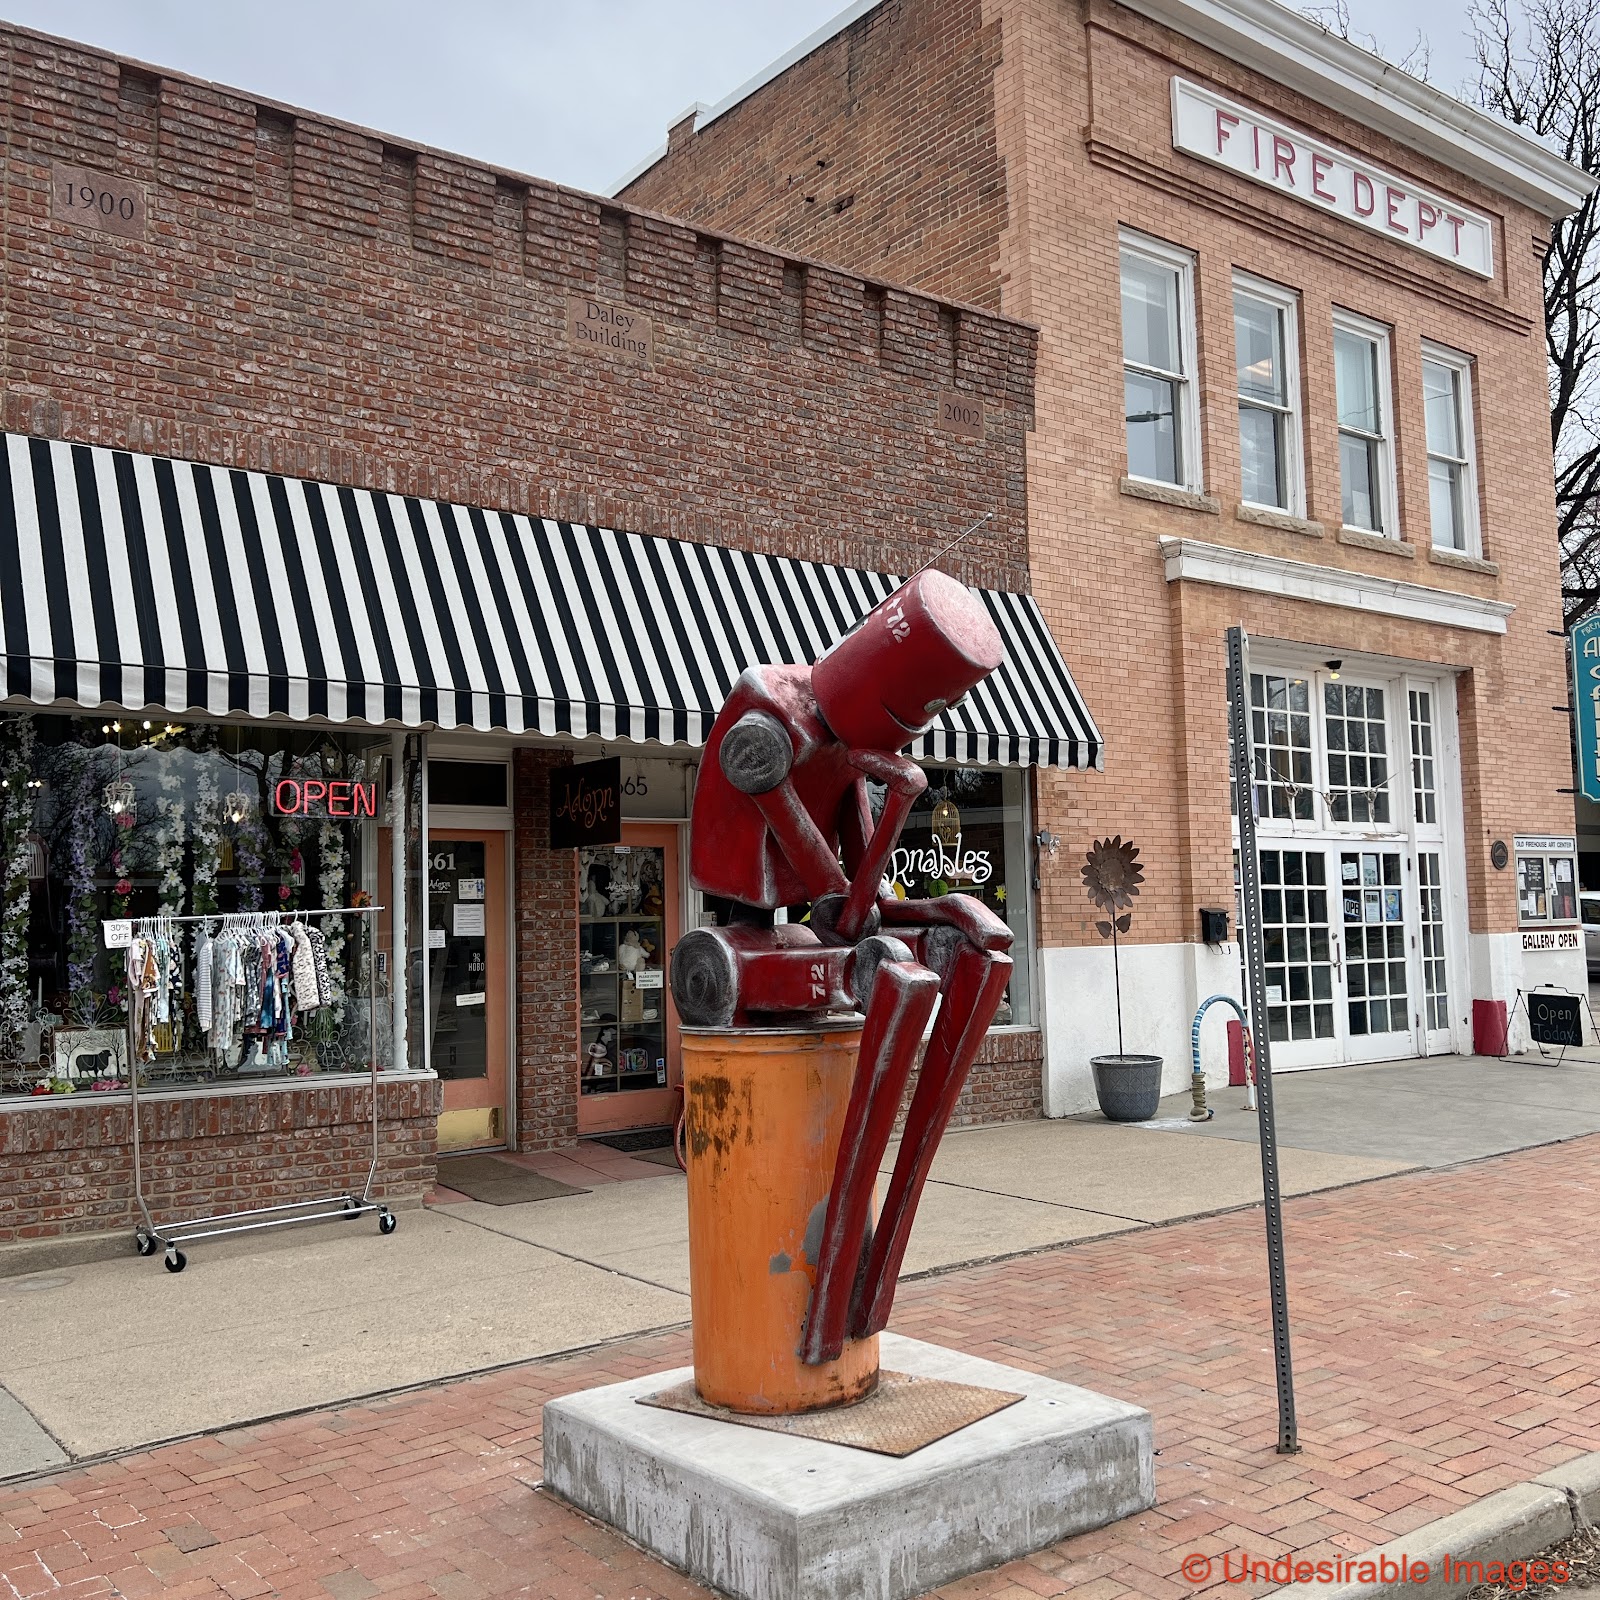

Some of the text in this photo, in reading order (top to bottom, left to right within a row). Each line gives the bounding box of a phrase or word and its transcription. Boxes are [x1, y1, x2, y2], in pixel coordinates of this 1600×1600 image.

[1216, 109, 1336, 203] FIRE
[65, 183, 135, 220] 1900
[586, 301, 635, 333] Daley
[576, 321, 647, 358] Building
[944, 403, 980, 427] 2002
[1581, 621, 1600, 637] FIREH
[275, 779, 376, 817] OPEN
[556, 777, 615, 829] Adorn
[1345, 900, 1360, 916] OPE
[110, 923, 130, 932] 30%
[110, 933, 130, 941] OFF
[1522, 933, 1578, 949] GALLERY OPEN
[468, 962, 485, 971] HOBO
[810, 963, 826, 999] 72
[1537, 1004, 1572, 1025] Open
[1533, 1023, 1575, 1045] Today
